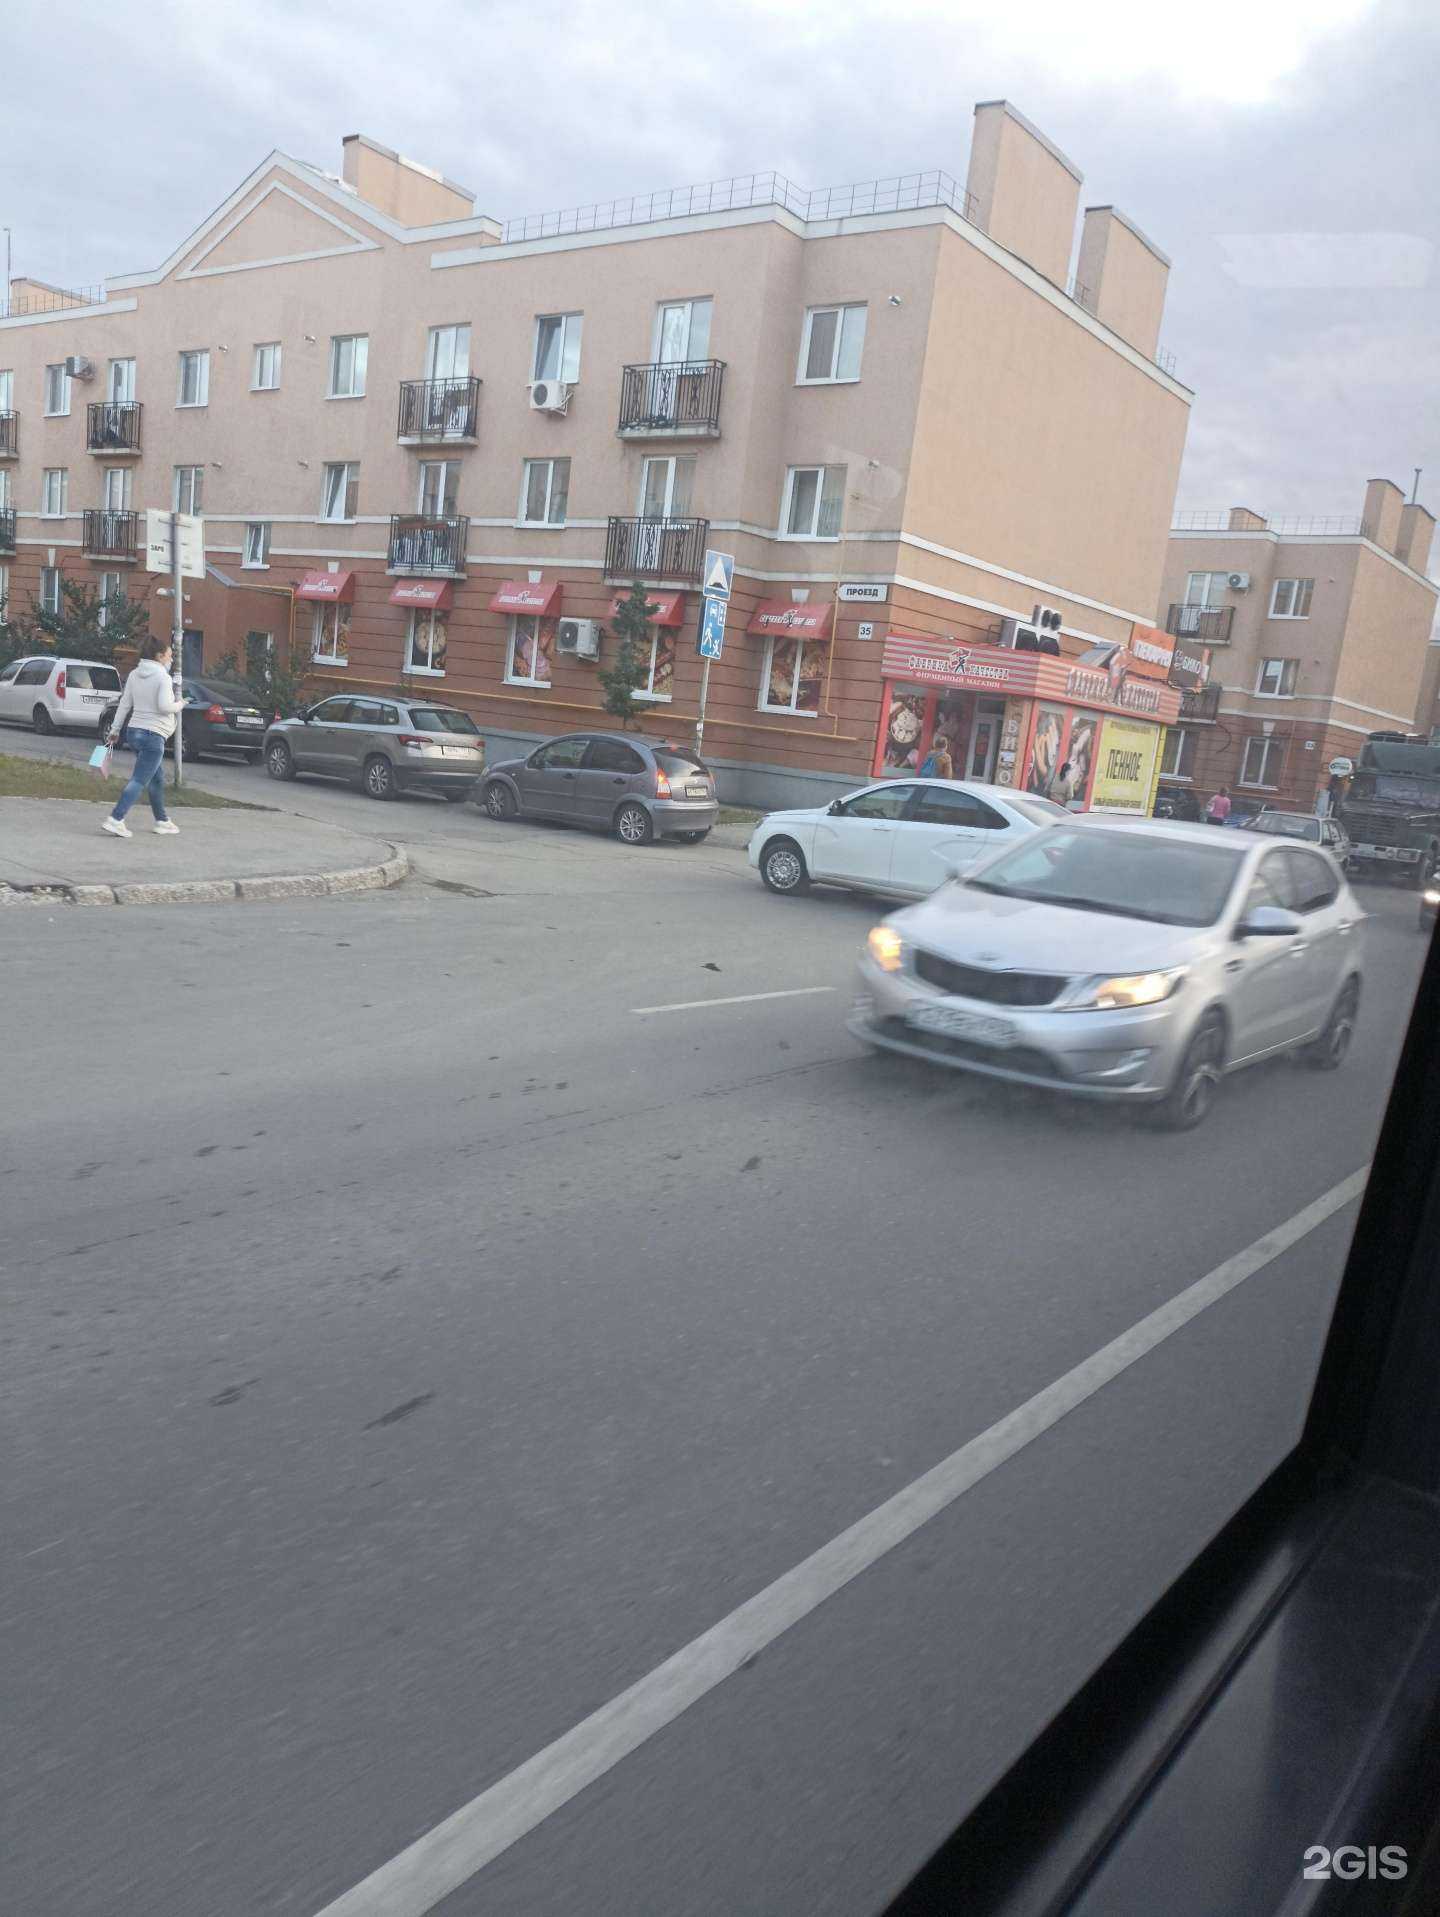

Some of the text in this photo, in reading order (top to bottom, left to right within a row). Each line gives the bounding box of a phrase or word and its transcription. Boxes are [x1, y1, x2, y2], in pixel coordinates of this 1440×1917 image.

[846, 588, 879, 597] ПРОЕЗД
[860, 626, 871, 635] 35
[966, 679, 1000, 689] МАГАЗИН
[1106, 748, 1143, 782] ПЕННОЕ
